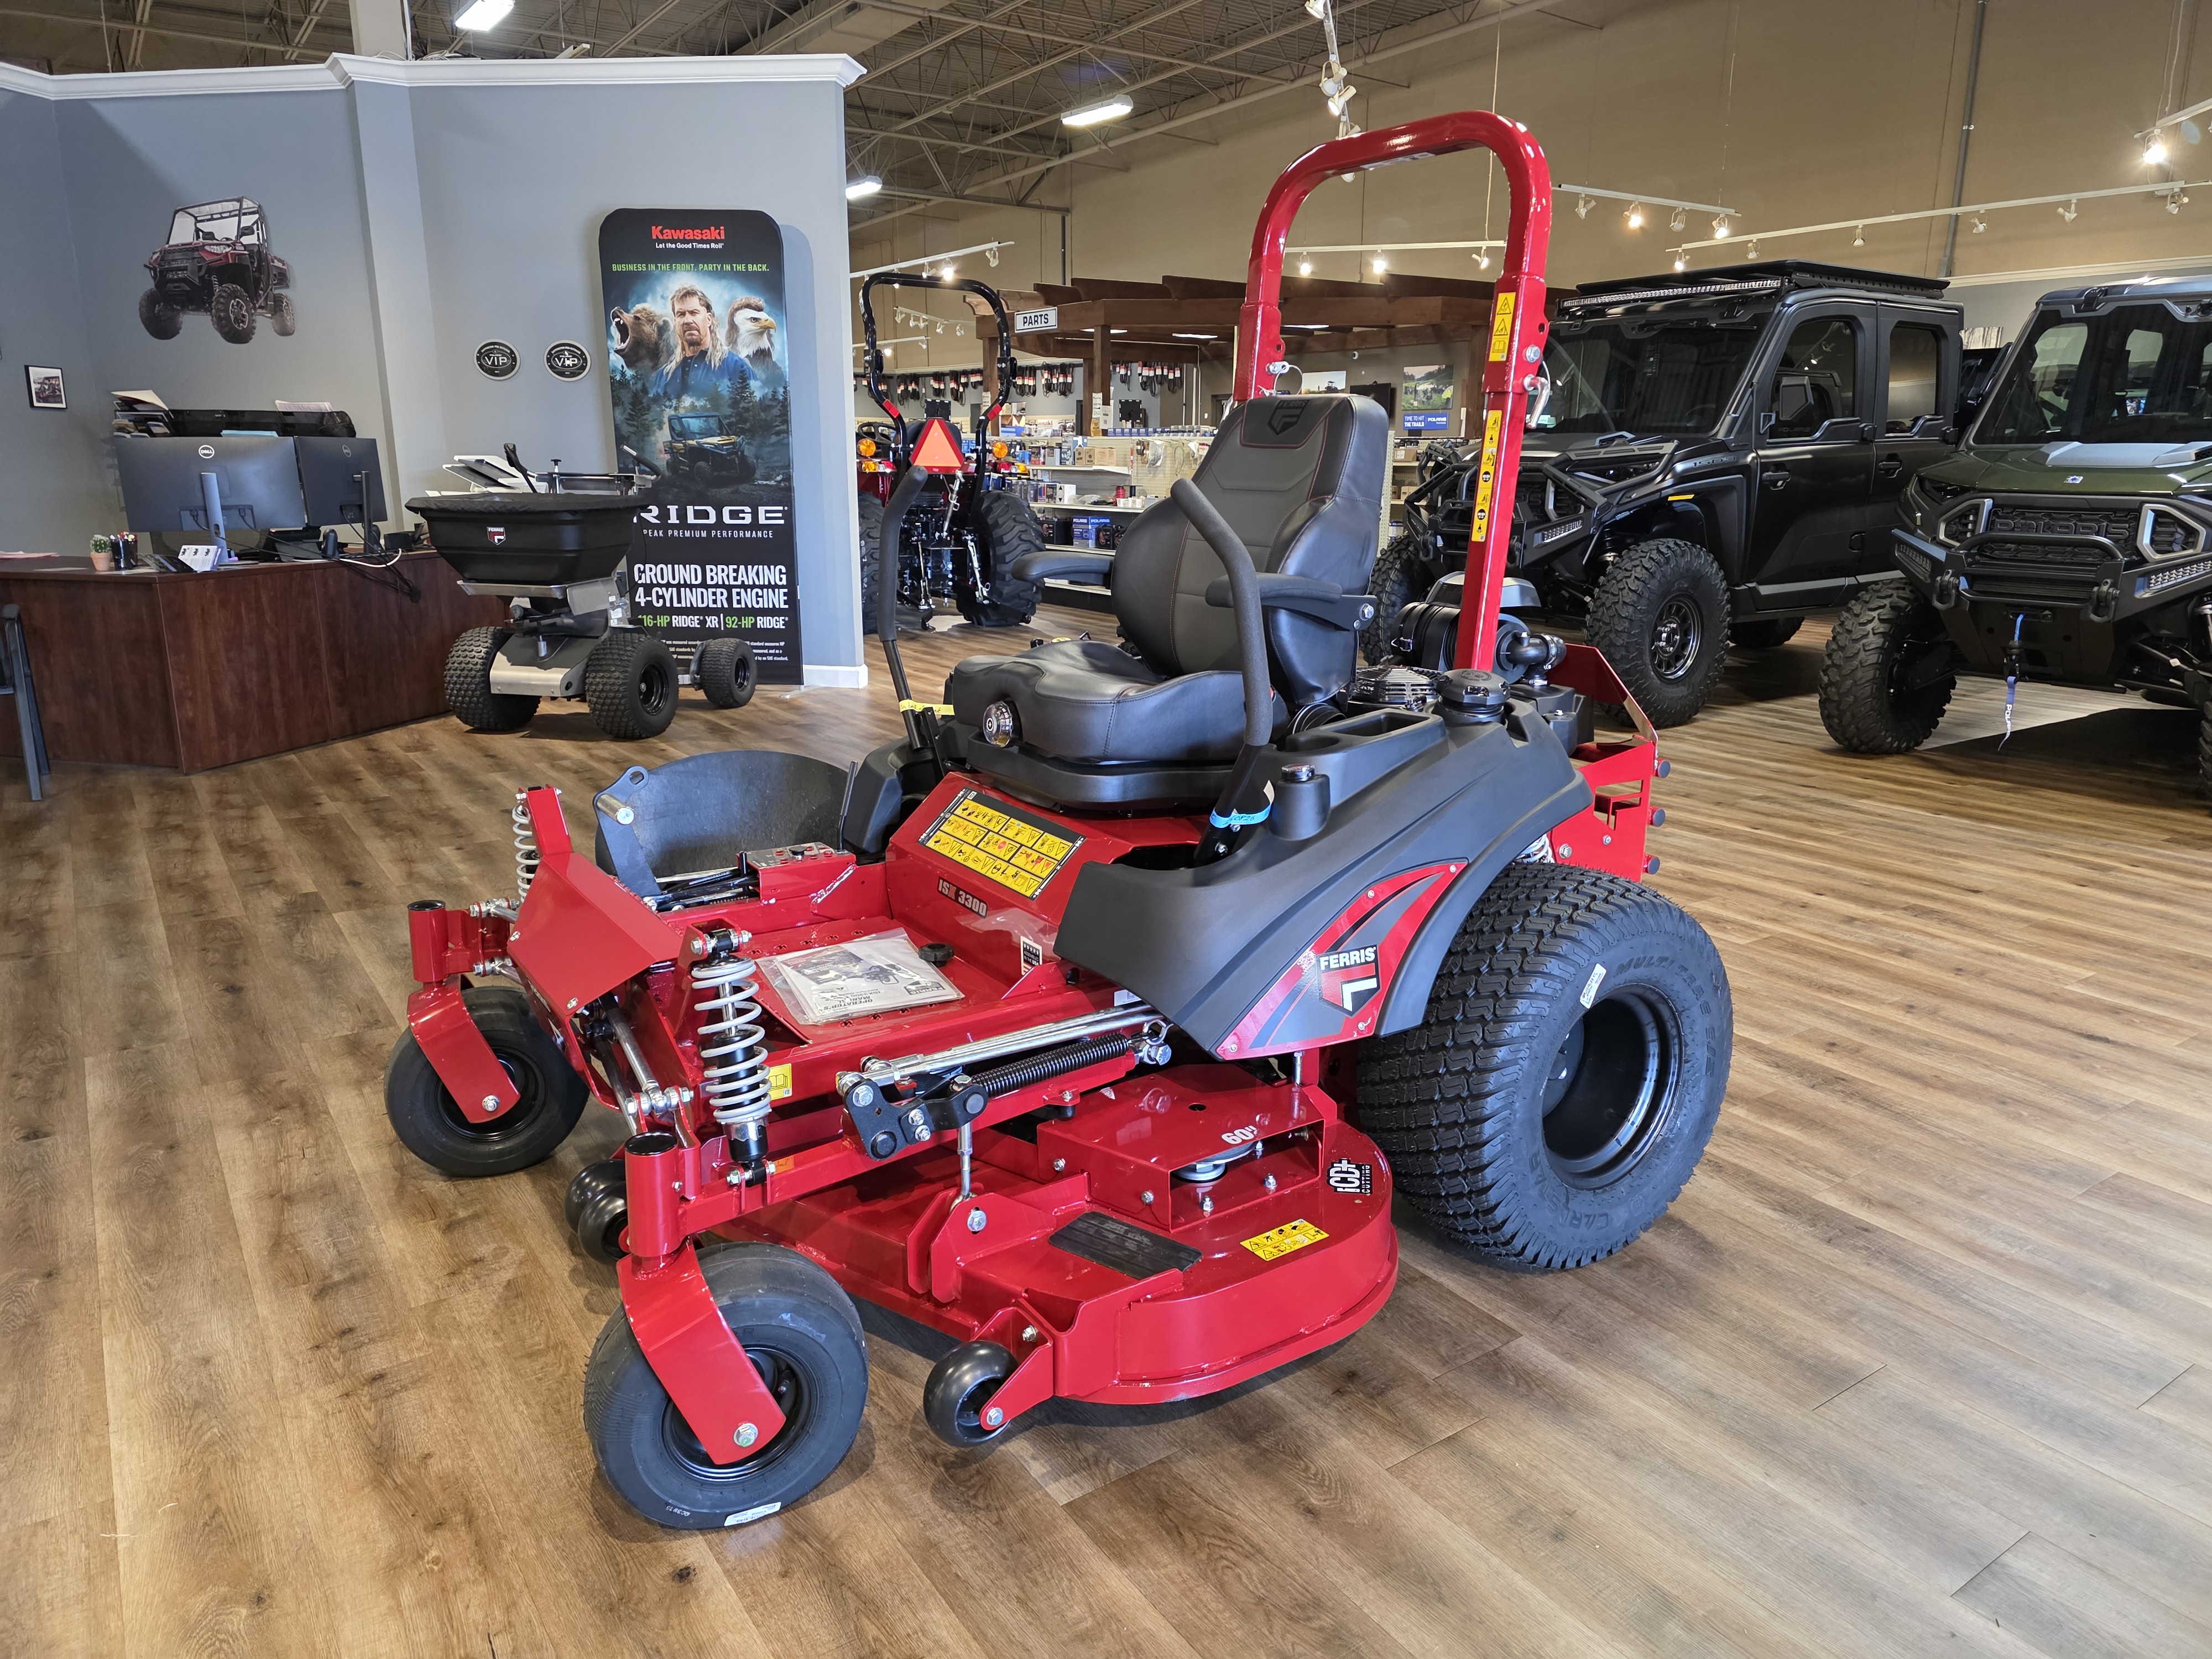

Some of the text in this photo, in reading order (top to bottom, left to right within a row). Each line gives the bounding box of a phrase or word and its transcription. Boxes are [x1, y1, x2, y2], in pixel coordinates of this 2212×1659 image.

[651, 226, 725, 239] Kawasaki
[1023, 314, 1048, 326] PARTS
[485, 357, 507, 365] VIP
[555, 358, 577, 366] VIP
[1693, 456, 1736, 467] 1500
[633, 505, 785, 524] RIDGE
[1995, 519, 2129, 540] POLARIS
[634, 564, 786, 585] GROUND BREAKING
[635, 587, 788, 608] 4-CYLINDER ENGINE
[638, 615, 670, 627] 16-HP
[705, 616, 719, 628] XR
[726, 617, 755, 628] 92-HP
[938, 879, 987, 917] ISX 3300
[1319, 947, 1376, 971] FERRIS
[1615, 956, 1675, 975] MULTI
[1676, 964, 1712, 1015] TRAC
[823, 999, 873, 1011] OPERATOR'S
[1221, 1125, 1257, 1145] 60"
[1329, 1160, 1360, 1193] ICD+
[1361, 1165, 1371, 1194] CUTTING
